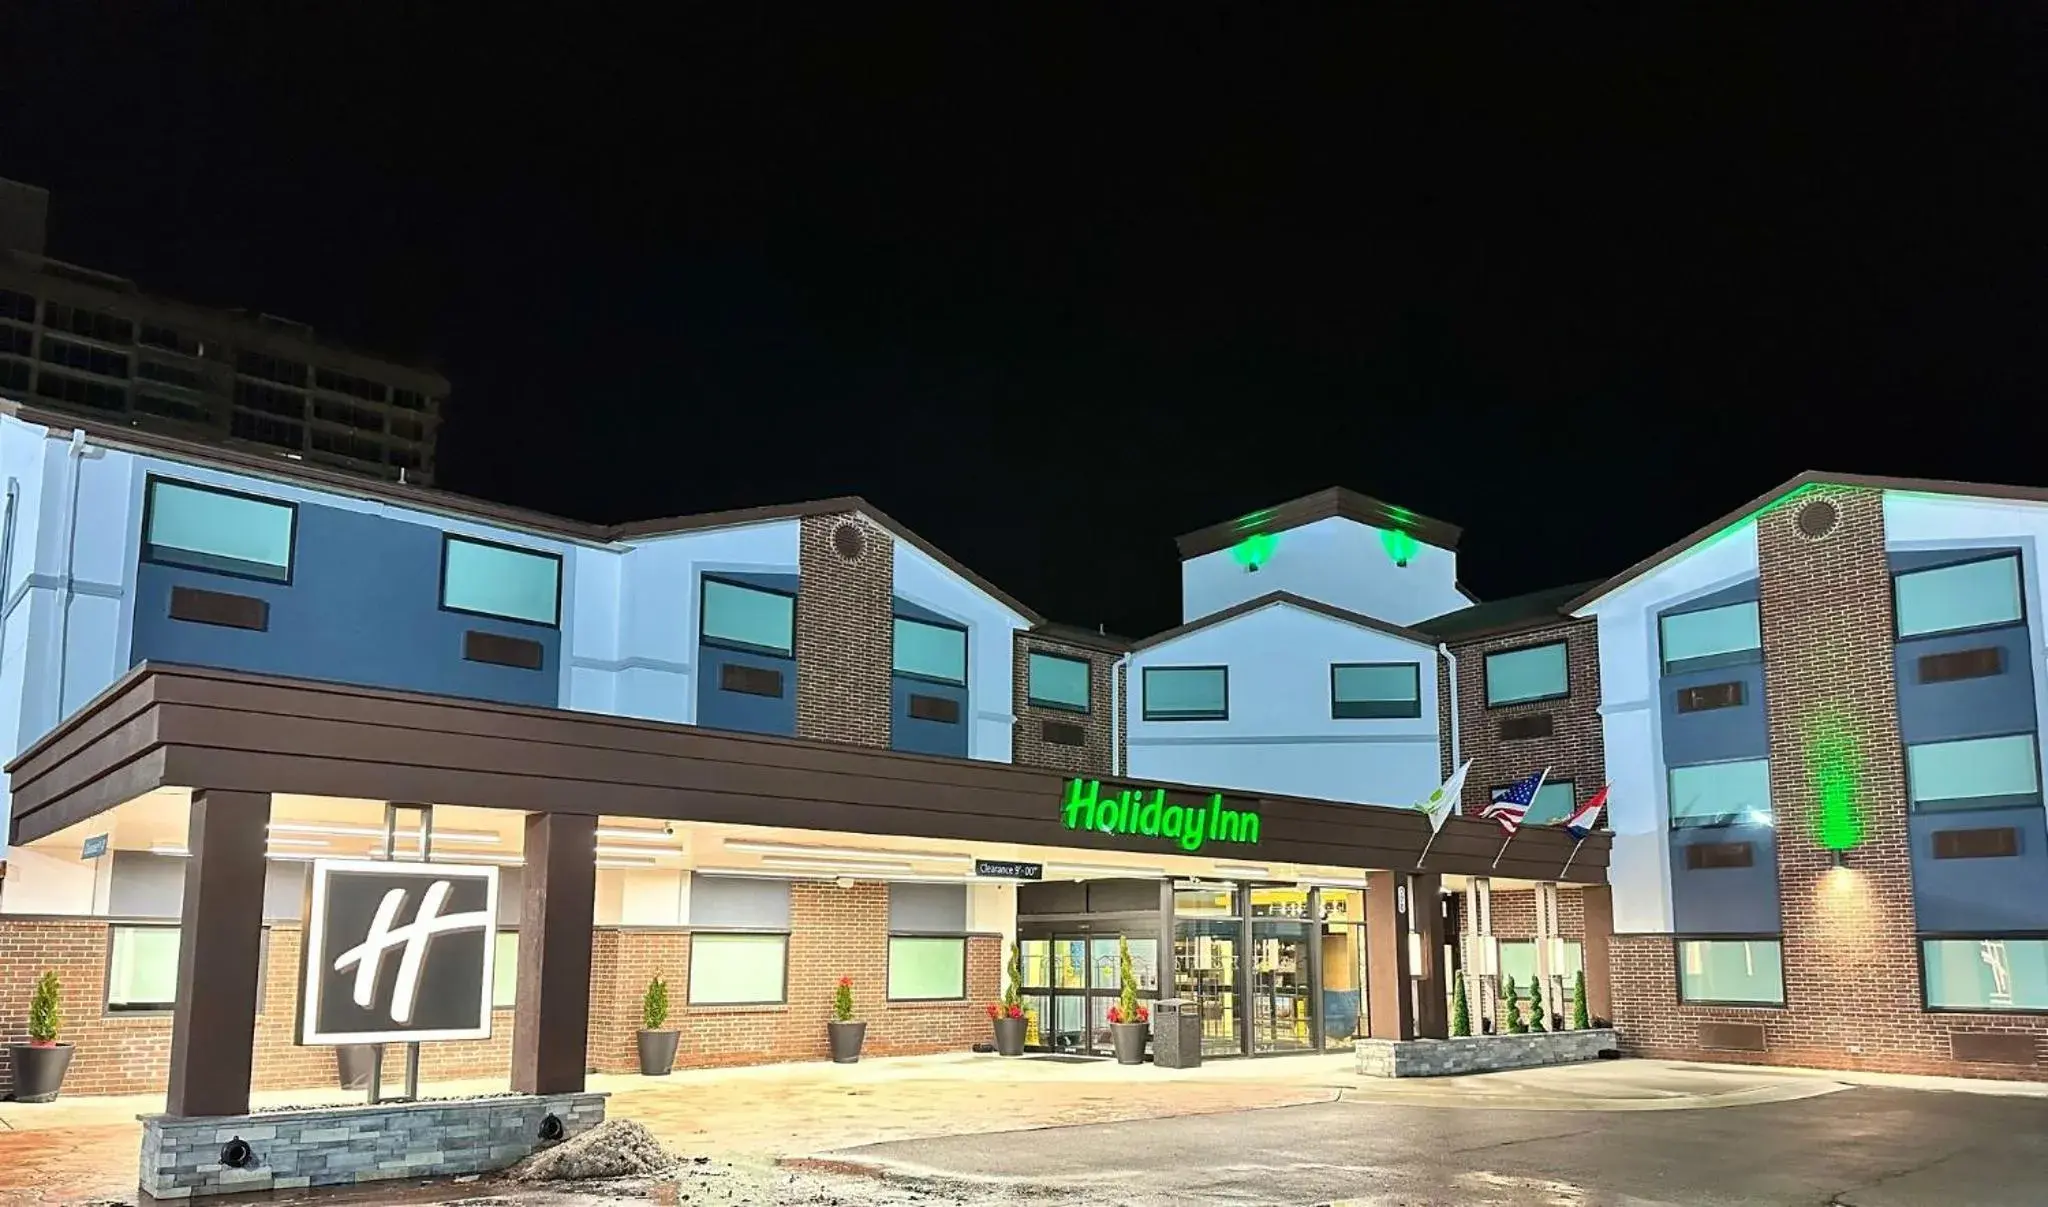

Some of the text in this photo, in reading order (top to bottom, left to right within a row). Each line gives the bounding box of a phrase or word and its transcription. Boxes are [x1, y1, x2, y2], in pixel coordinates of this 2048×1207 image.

[1064, 778, 1261, 850] Holiday Inn
[980, 864, 1013, 875] Clearance
[334, 880, 487, 1022] H
